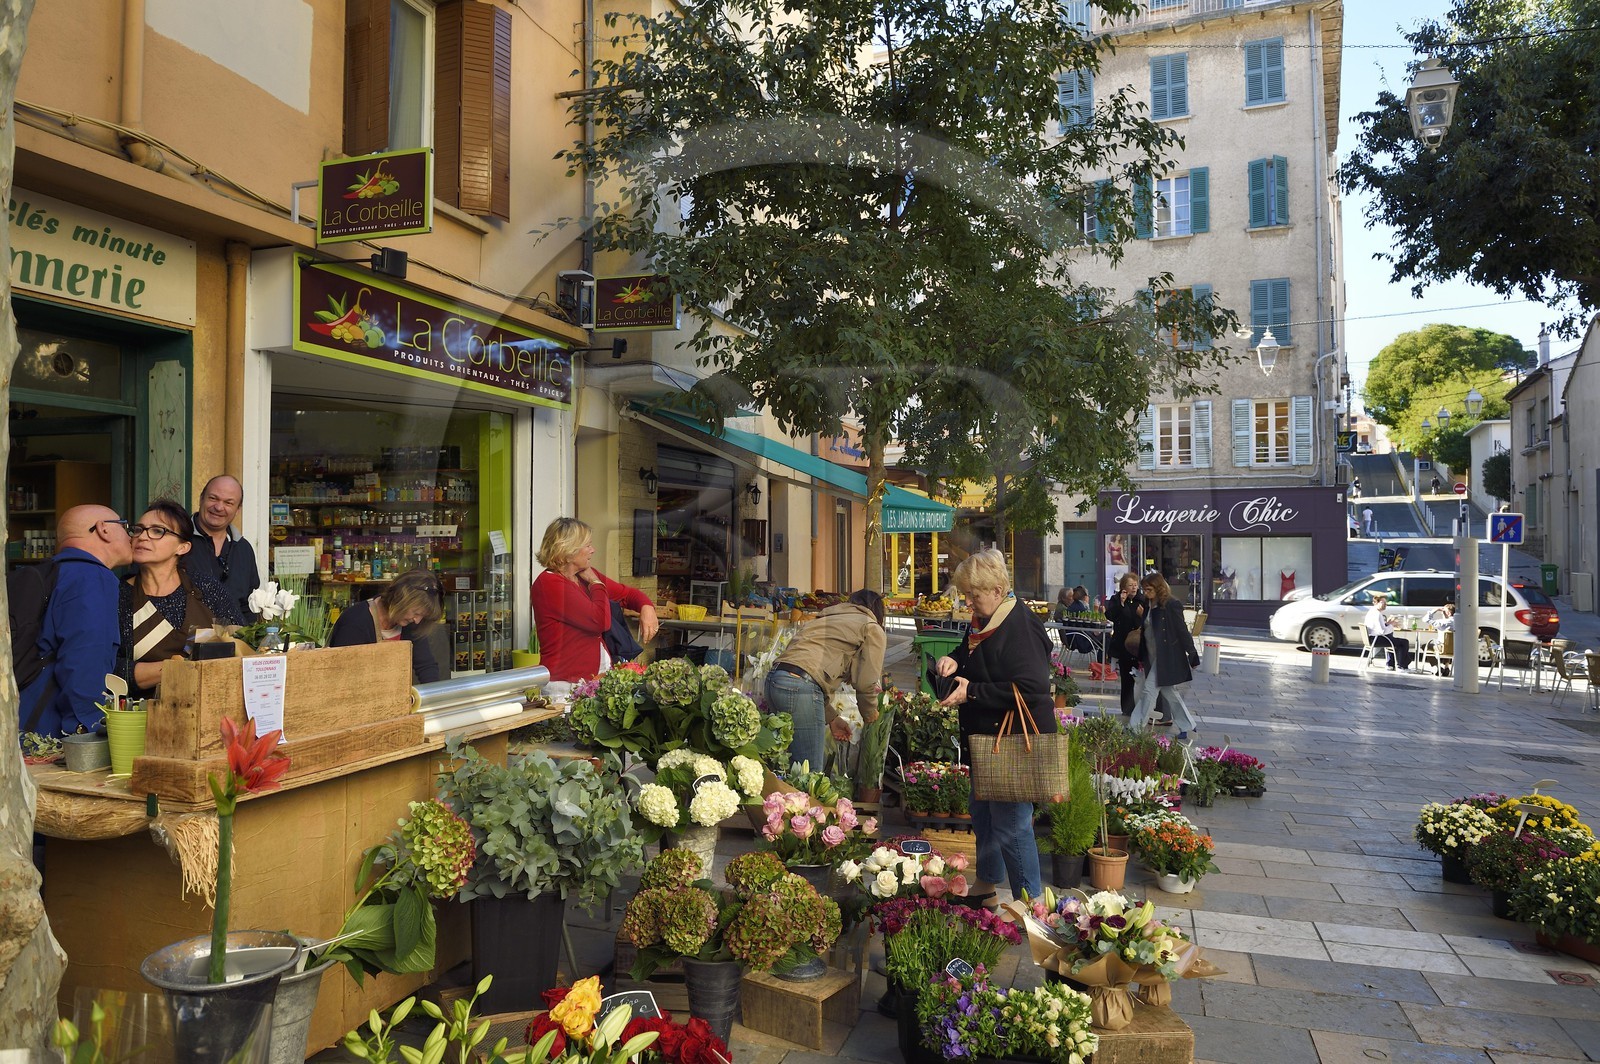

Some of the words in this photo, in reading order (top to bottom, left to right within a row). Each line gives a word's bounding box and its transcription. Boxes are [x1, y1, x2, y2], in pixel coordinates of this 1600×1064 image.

[324, 209, 341, 226] La
[346, 199, 423, 224] Corbeille
[72, 226, 166, 265] minute
[597, 309, 612, 321] La
[396, 301, 432, 351] La
[442, 317, 563, 386] Corbeille
[394, 350, 445, 369] PRODUITS
[449, 364, 500, 382] ORIENTAUX
[539, 386, 564, 398] ÉPICES
[886, 509, 896, 529] LES
[897, 510, 918, 529] JARDINS
[919, 511, 925, 529] DE
[925, 512, 947, 529] PROVENCE
[1114, 493, 1221, 533] Lingerie
[1228, 496, 1299, 532] Chic
